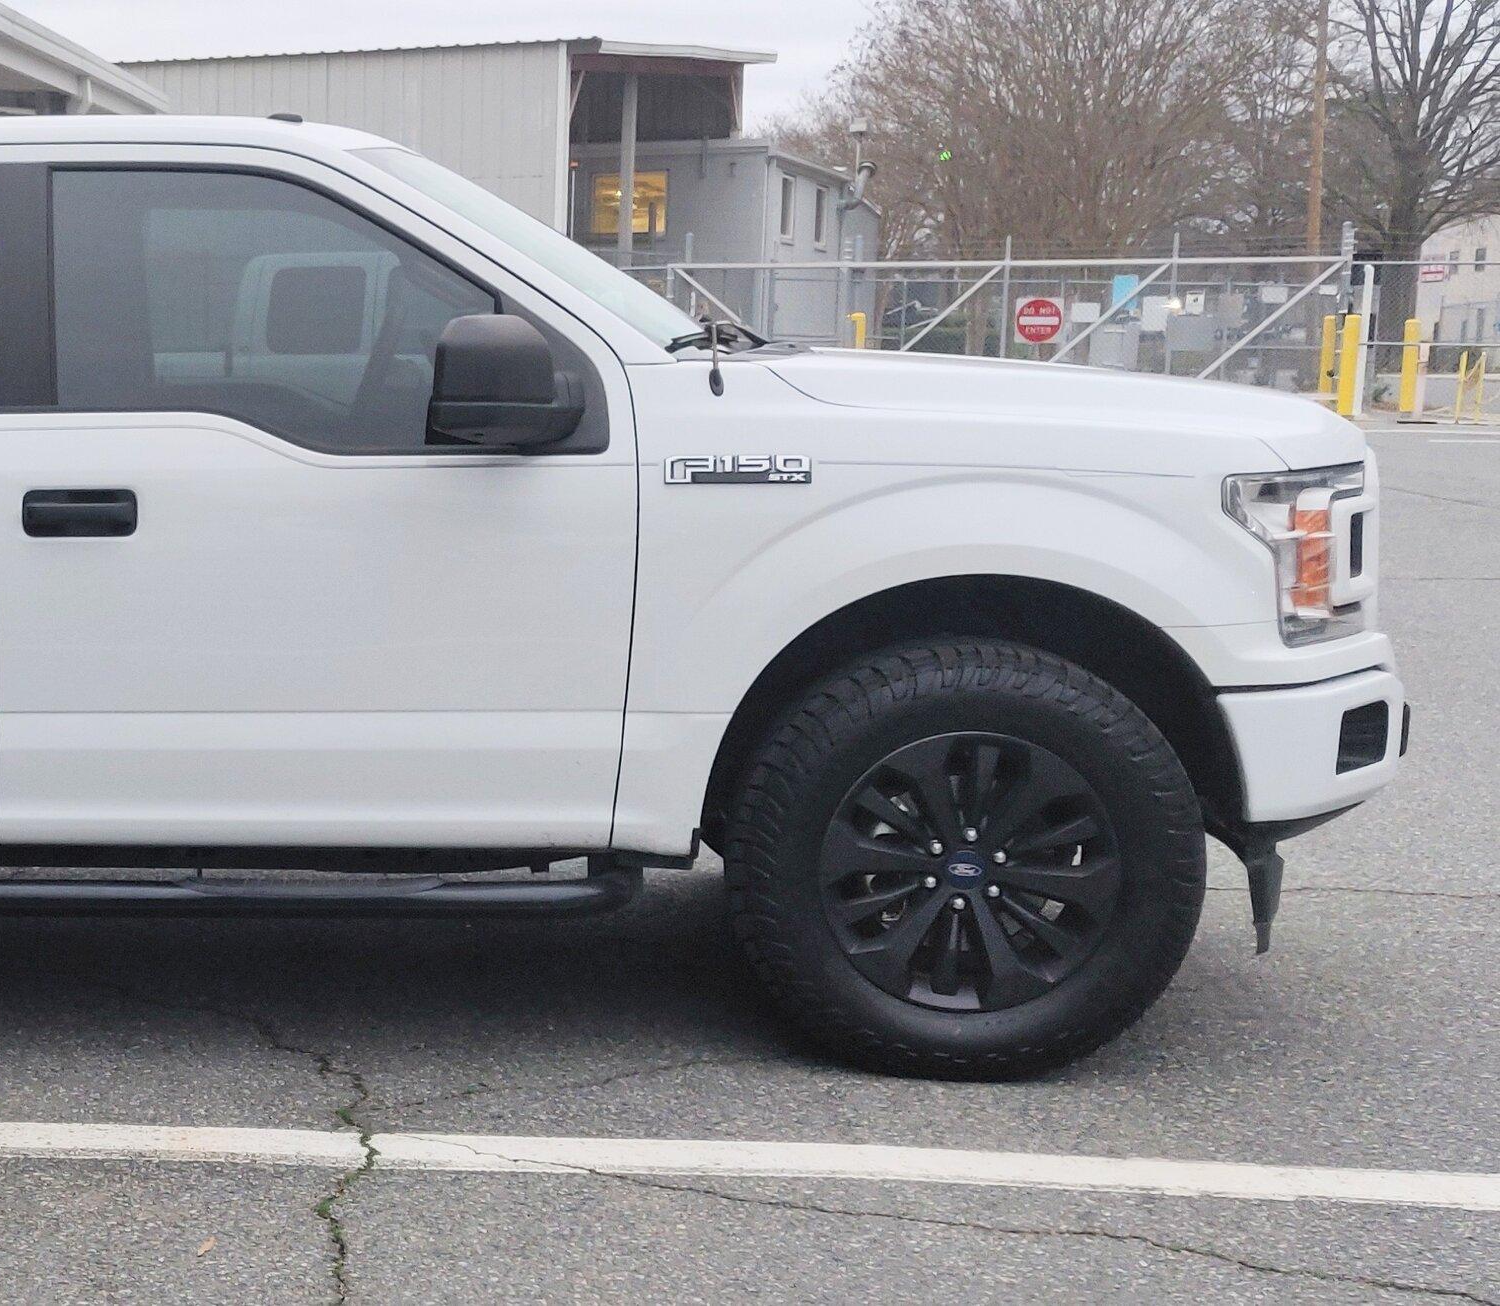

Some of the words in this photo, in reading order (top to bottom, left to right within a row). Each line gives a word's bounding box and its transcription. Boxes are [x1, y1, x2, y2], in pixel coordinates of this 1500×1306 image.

[1023, 306, 1035, 315] DO
[1039, 306, 1056, 315] NOT
[1025, 326, 1052, 334] ENTER
[767, 472, 806, 482] STX
